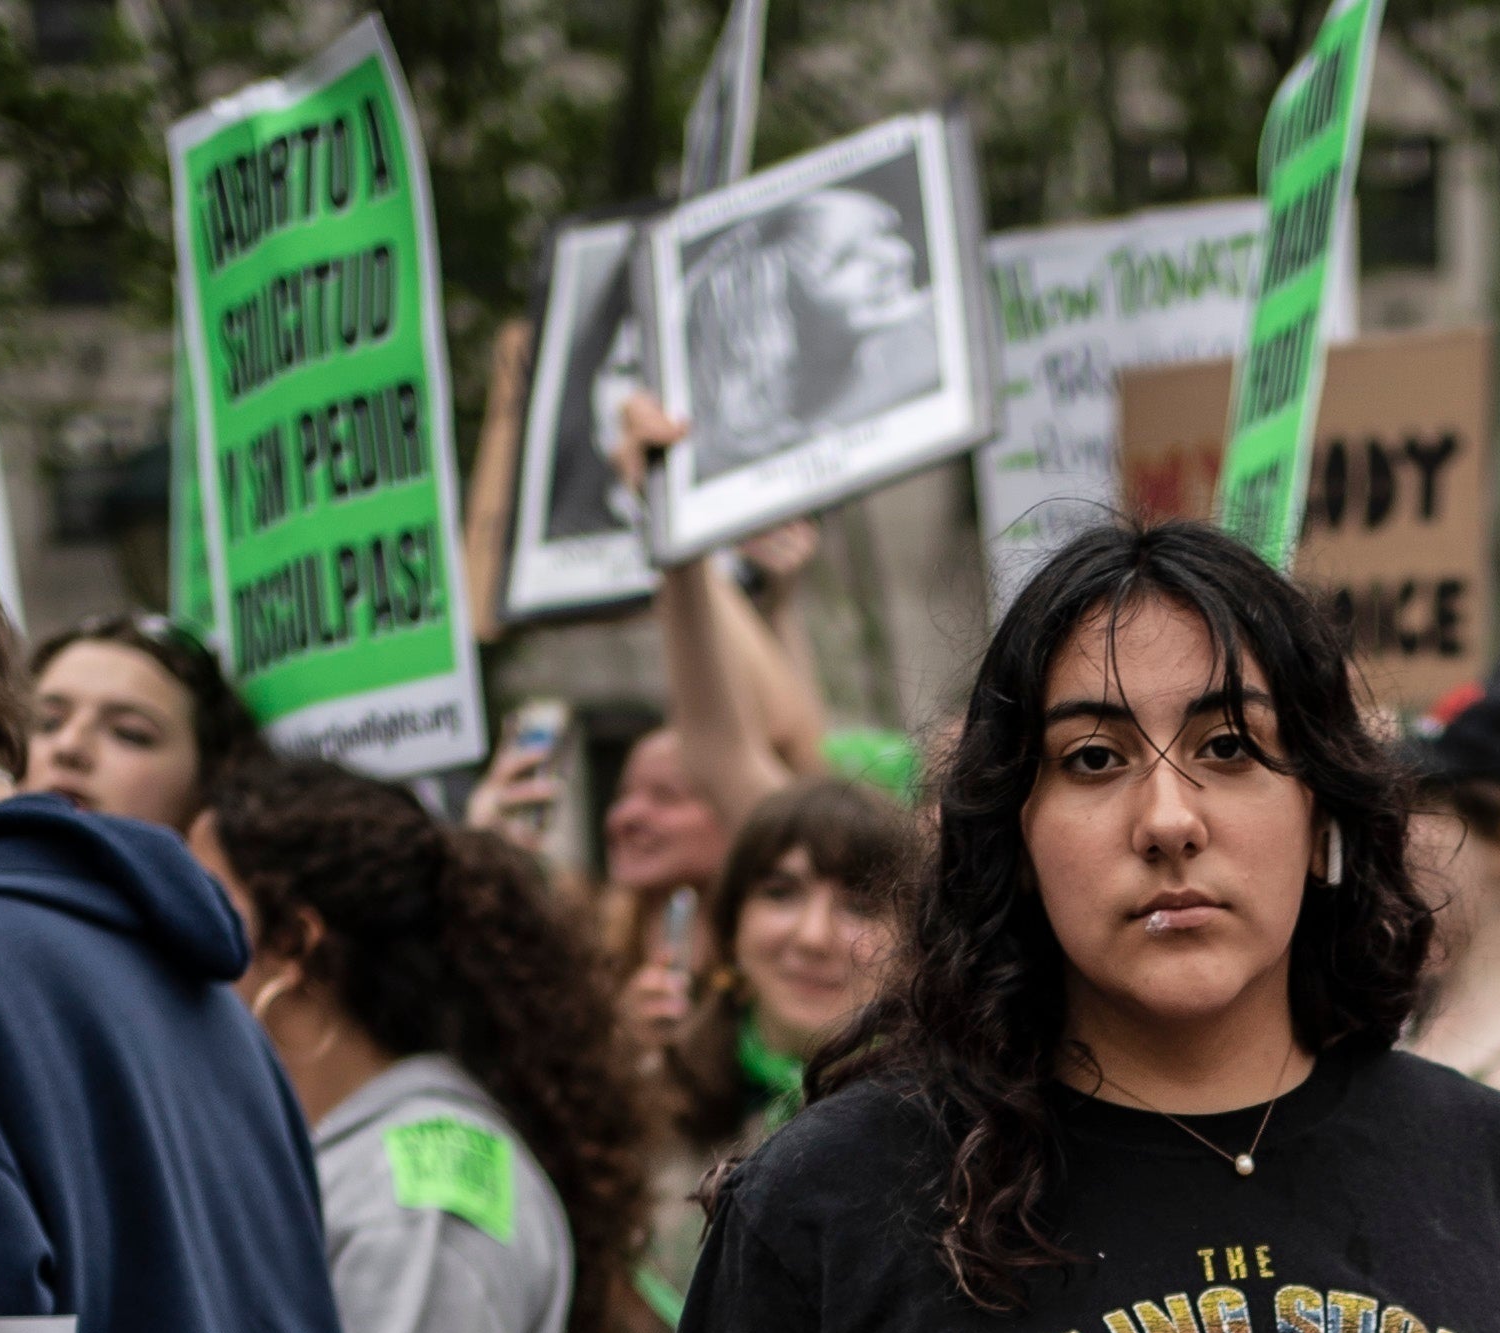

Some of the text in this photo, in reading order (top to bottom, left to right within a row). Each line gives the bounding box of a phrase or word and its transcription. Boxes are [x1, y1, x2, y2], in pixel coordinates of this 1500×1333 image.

[295, 382, 427, 512] PEDIR
[1306, 430, 1460, 532] ODY
[1198, 1245, 1276, 1281] THE
